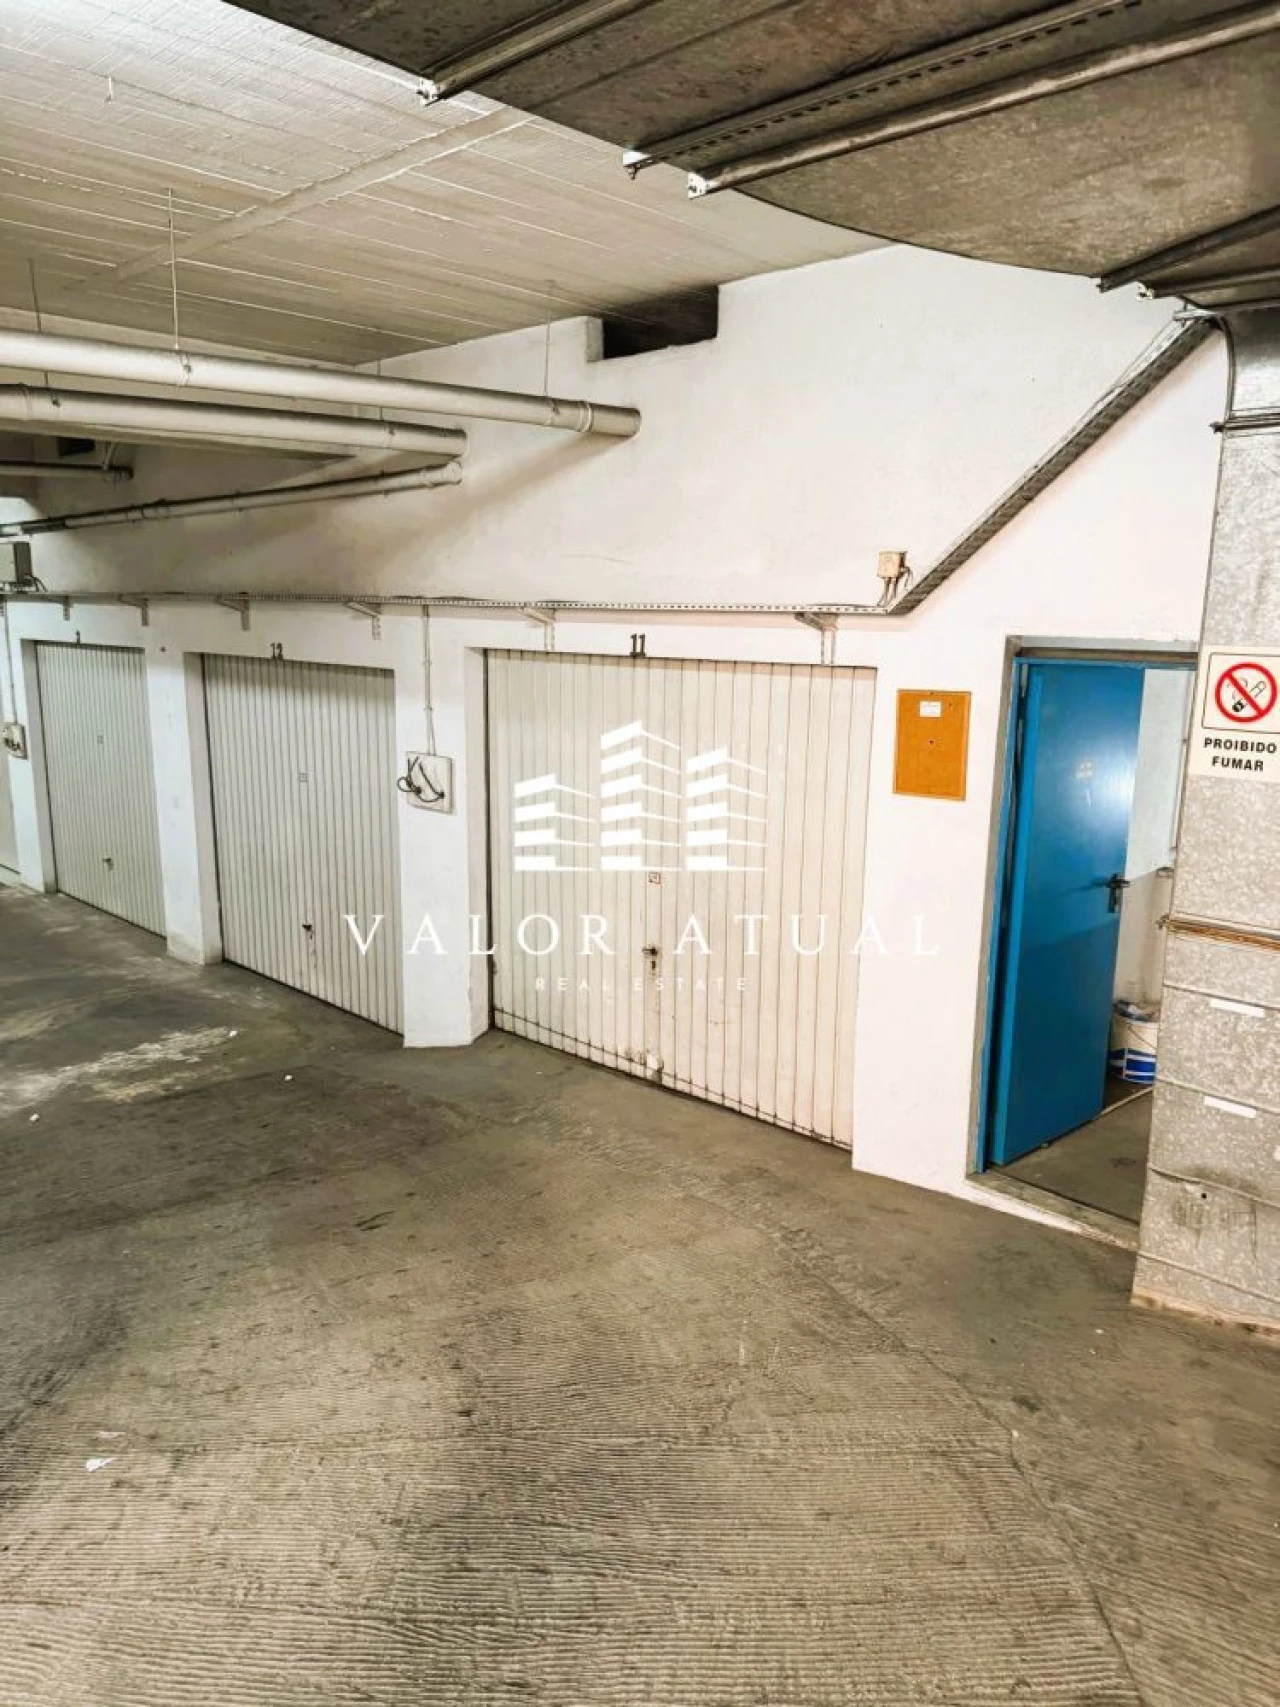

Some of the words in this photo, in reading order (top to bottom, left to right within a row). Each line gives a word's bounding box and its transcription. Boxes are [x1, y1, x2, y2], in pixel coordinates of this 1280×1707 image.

[629, 633, 647, 657] 11
[1203, 737, 1277, 754] PROIBIDO
[1211, 756, 1264, 772] FUMAR
